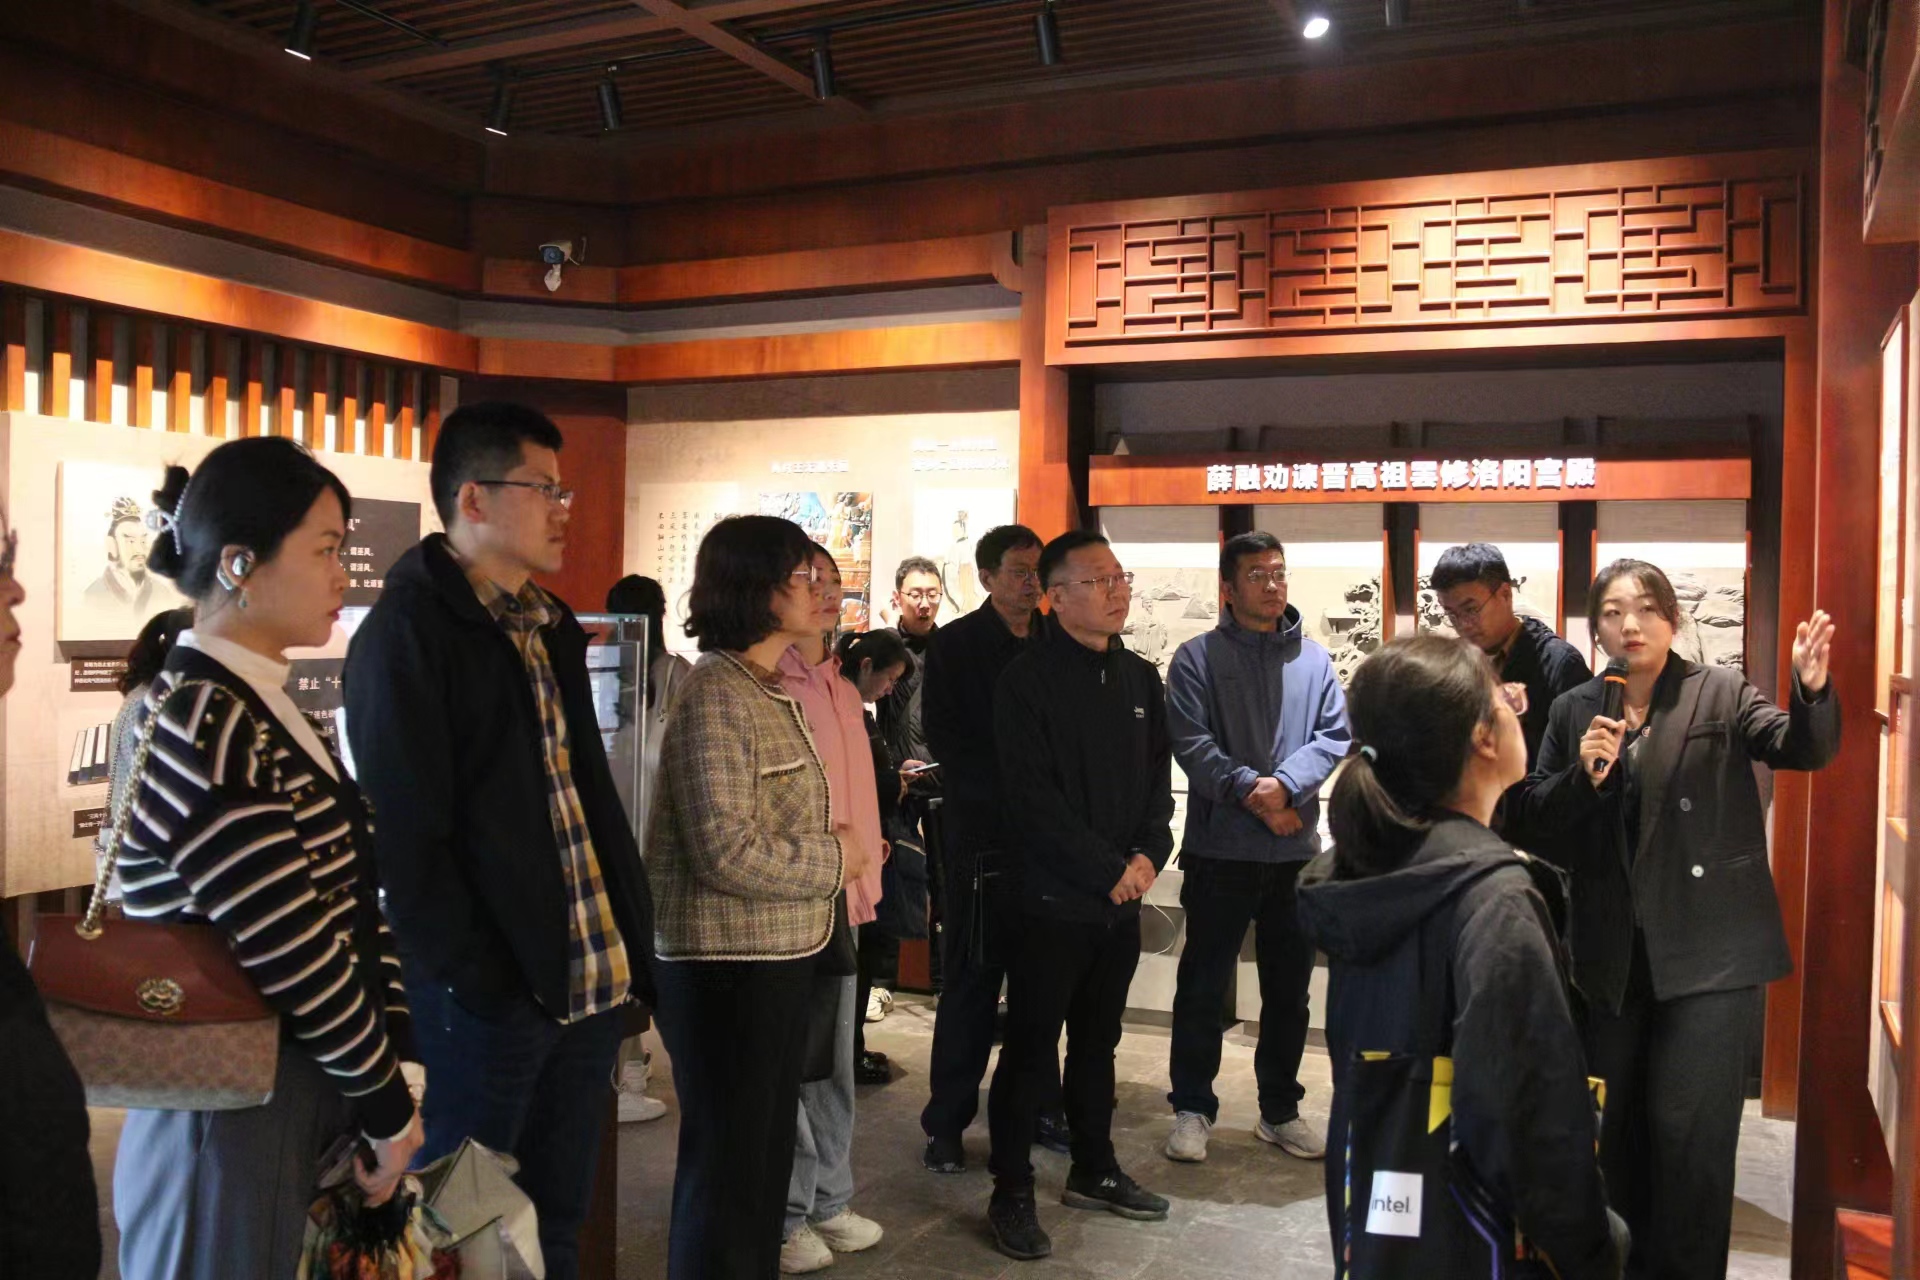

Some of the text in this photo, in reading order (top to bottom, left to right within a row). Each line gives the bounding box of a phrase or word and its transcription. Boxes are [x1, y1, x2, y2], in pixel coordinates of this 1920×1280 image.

[1206, 458, 1596, 491] 薛融劝谏晋高祖罢修洛阳宫殿
